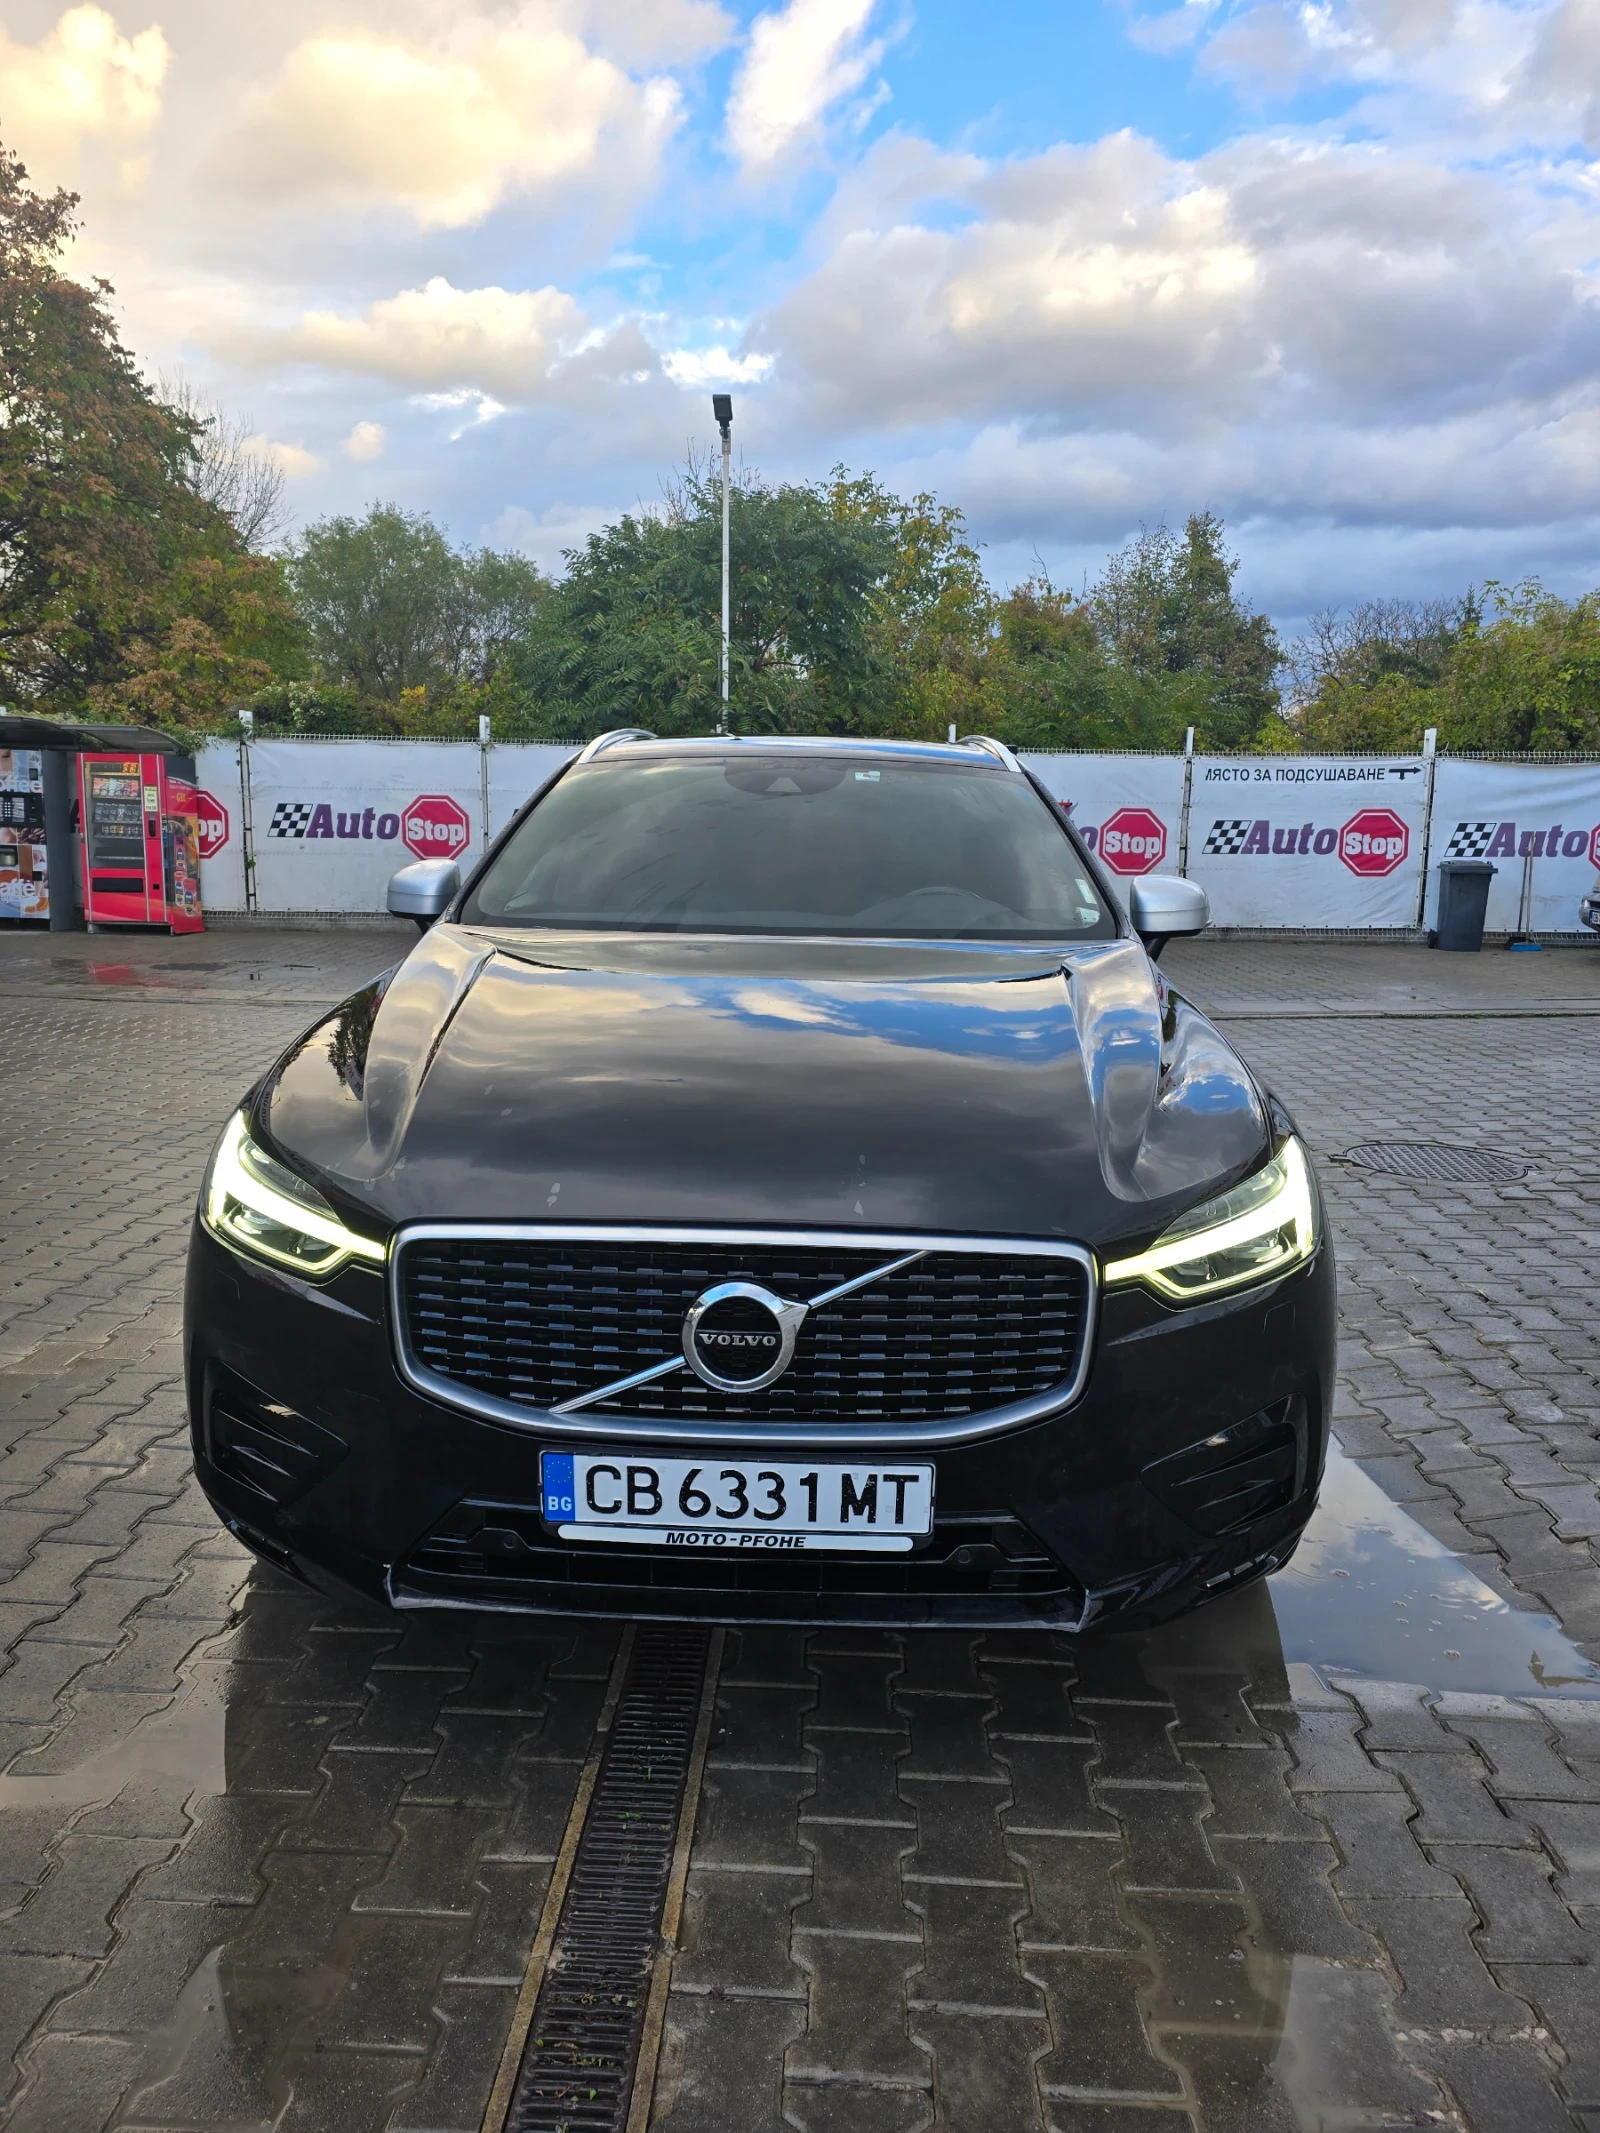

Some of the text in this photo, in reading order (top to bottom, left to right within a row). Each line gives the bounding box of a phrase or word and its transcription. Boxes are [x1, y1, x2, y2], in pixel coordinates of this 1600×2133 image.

[1254, 768, 1272, 781] ЗА
[1276, 768, 1386, 783] ПОДСУШАВАНЕ
[306, 803, 464, 846] Auto Stop
[1105, 830, 1160, 859] Stop
[1241, 820, 1405, 860] Auto Stop
[1485, 822, 1590, 858] Auto
[698, 1333, 777, 1347] VOLVO
[547, 1496, 573, 1511] BG
[585, 1464, 920, 1525] CB 6331 MT
[665, 1532, 807, 1548] MOTO-PFOHE
